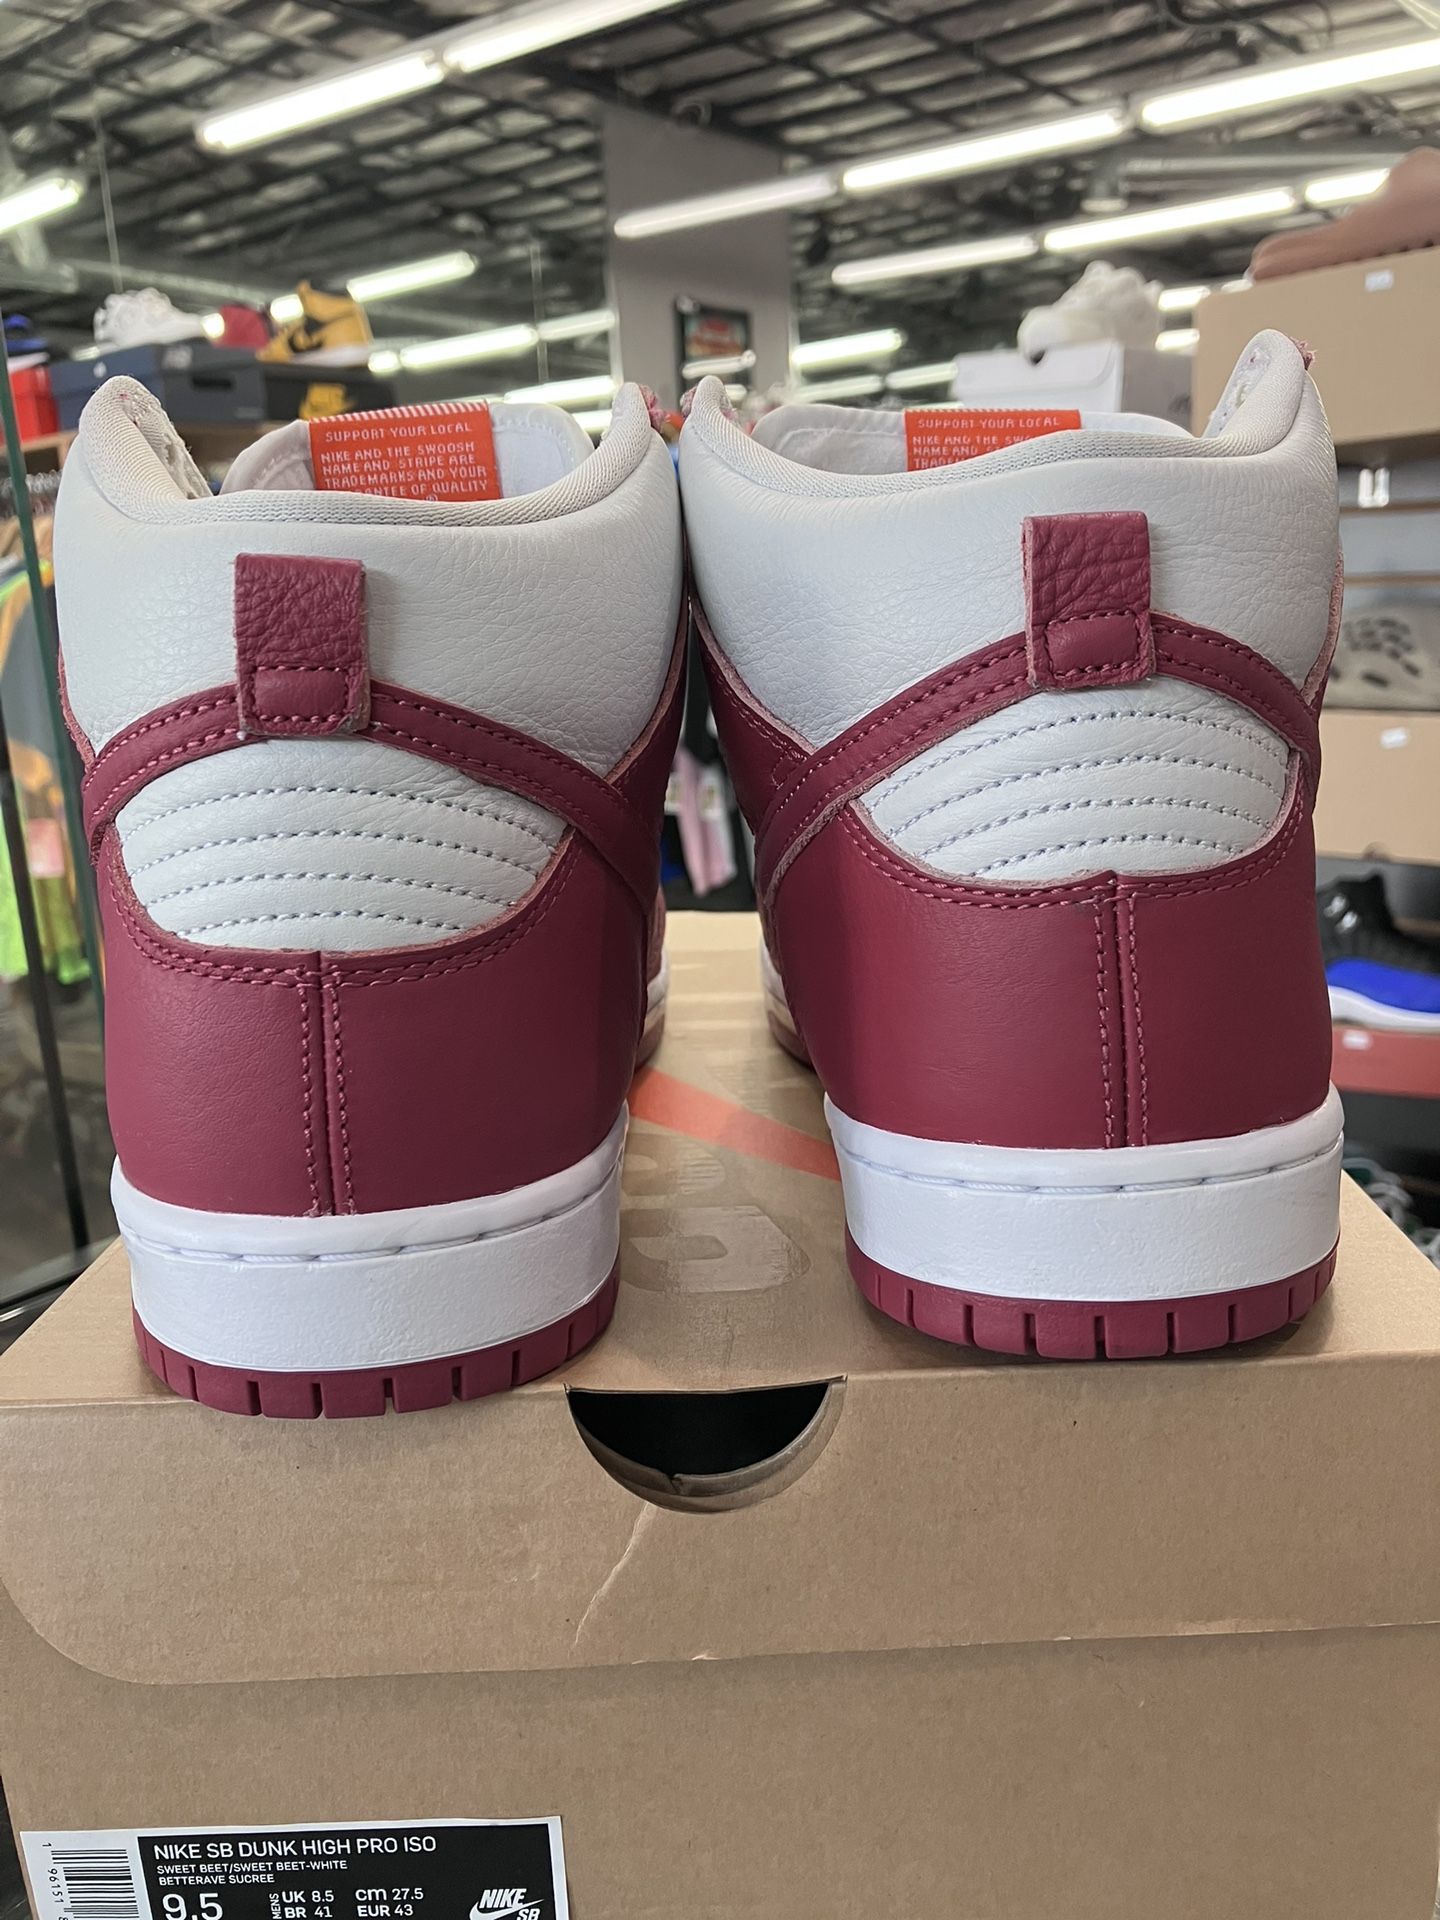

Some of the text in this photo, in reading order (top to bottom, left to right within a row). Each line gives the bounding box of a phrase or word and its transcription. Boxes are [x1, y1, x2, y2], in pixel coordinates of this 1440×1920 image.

[325, 422, 473, 442] SUPPORT YOUR LOCAL
[918, 417, 1060, 429] SUPPORT YOUR LOCAL
[912, 436, 940, 446] NIKE
[944, 436, 971, 446] AND
[976, 436, 998, 446] THE
[321, 442, 475, 464] NIKE AND THE SWOOSH
[912, 446, 949, 457] NAME
[952, 446, 978, 457] AND
[322, 454, 476, 476] NAME AND STRIPE ARE
[324, 465, 488, 490] TRADEMARKS AND YOUR
[411, 485, 427, 497] OF
[432, 479, 489, 494] QUALITY
[153, 1835, 437, 1860] NIKE SB DUNK HIGH PRO ISO
[156, 1860, 348, 1875] SWEET BEET/SWEET BEET-WHITE
[47, 1868, 64, 1904] 96151
[159, 1873, 275, 1886] BETTERAVE SUCREE
[282, 1889, 335, 1904] UK 8.5
[355, 1887, 424, 1901] cm 27.5
[479, 1888, 527, 1909] NIKE
[161, 1892, 224, 1920] 9.5
[269, 1893, 282, 1920] MENS
[284, 1905, 333, 1920] BR 41
[357, 1903, 414, 1918] EUR 43
